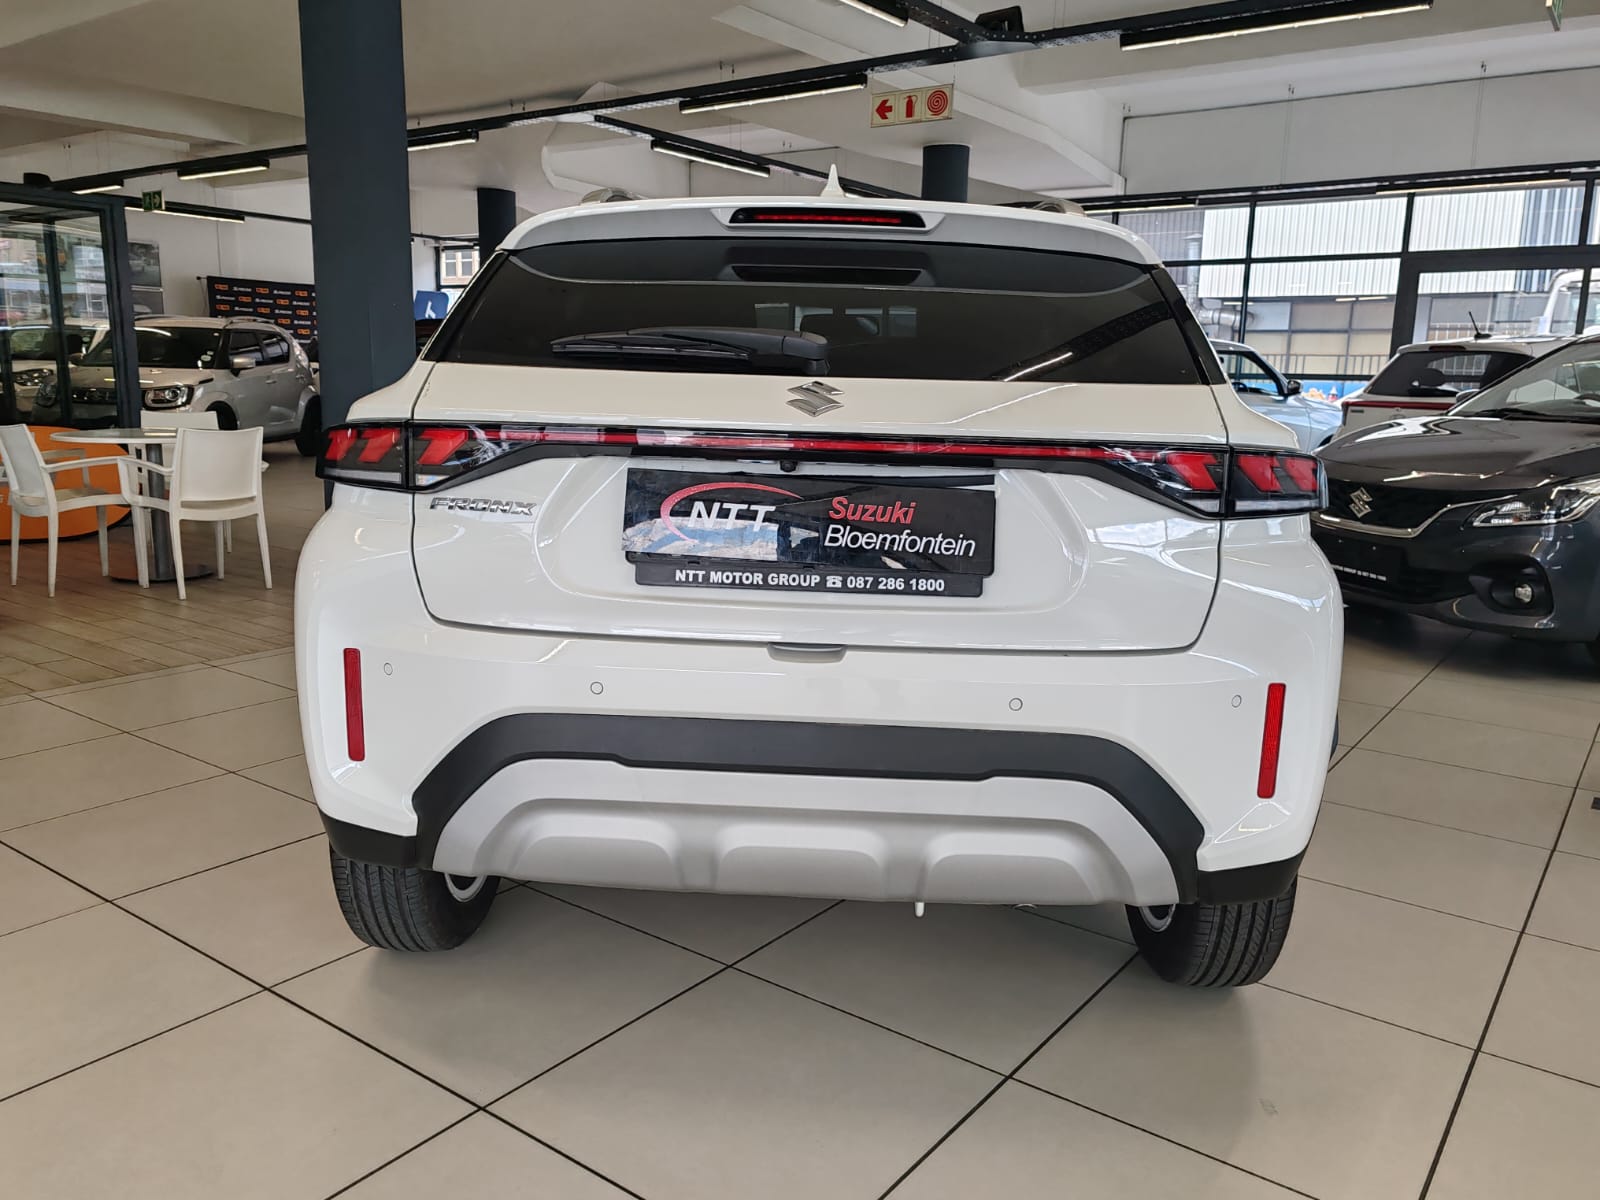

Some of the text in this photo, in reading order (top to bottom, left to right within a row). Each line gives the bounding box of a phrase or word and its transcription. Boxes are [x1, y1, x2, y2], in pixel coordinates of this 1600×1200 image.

[430, 497, 536, 516] FRONX
[687, 500, 779, 532] NTT
[828, 497, 917, 525] Suzuki
[824, 525, 976, 557] Bloemfontein
[675, 570, 945, 592] NTT MOTOR GROUP 087 286 1800
